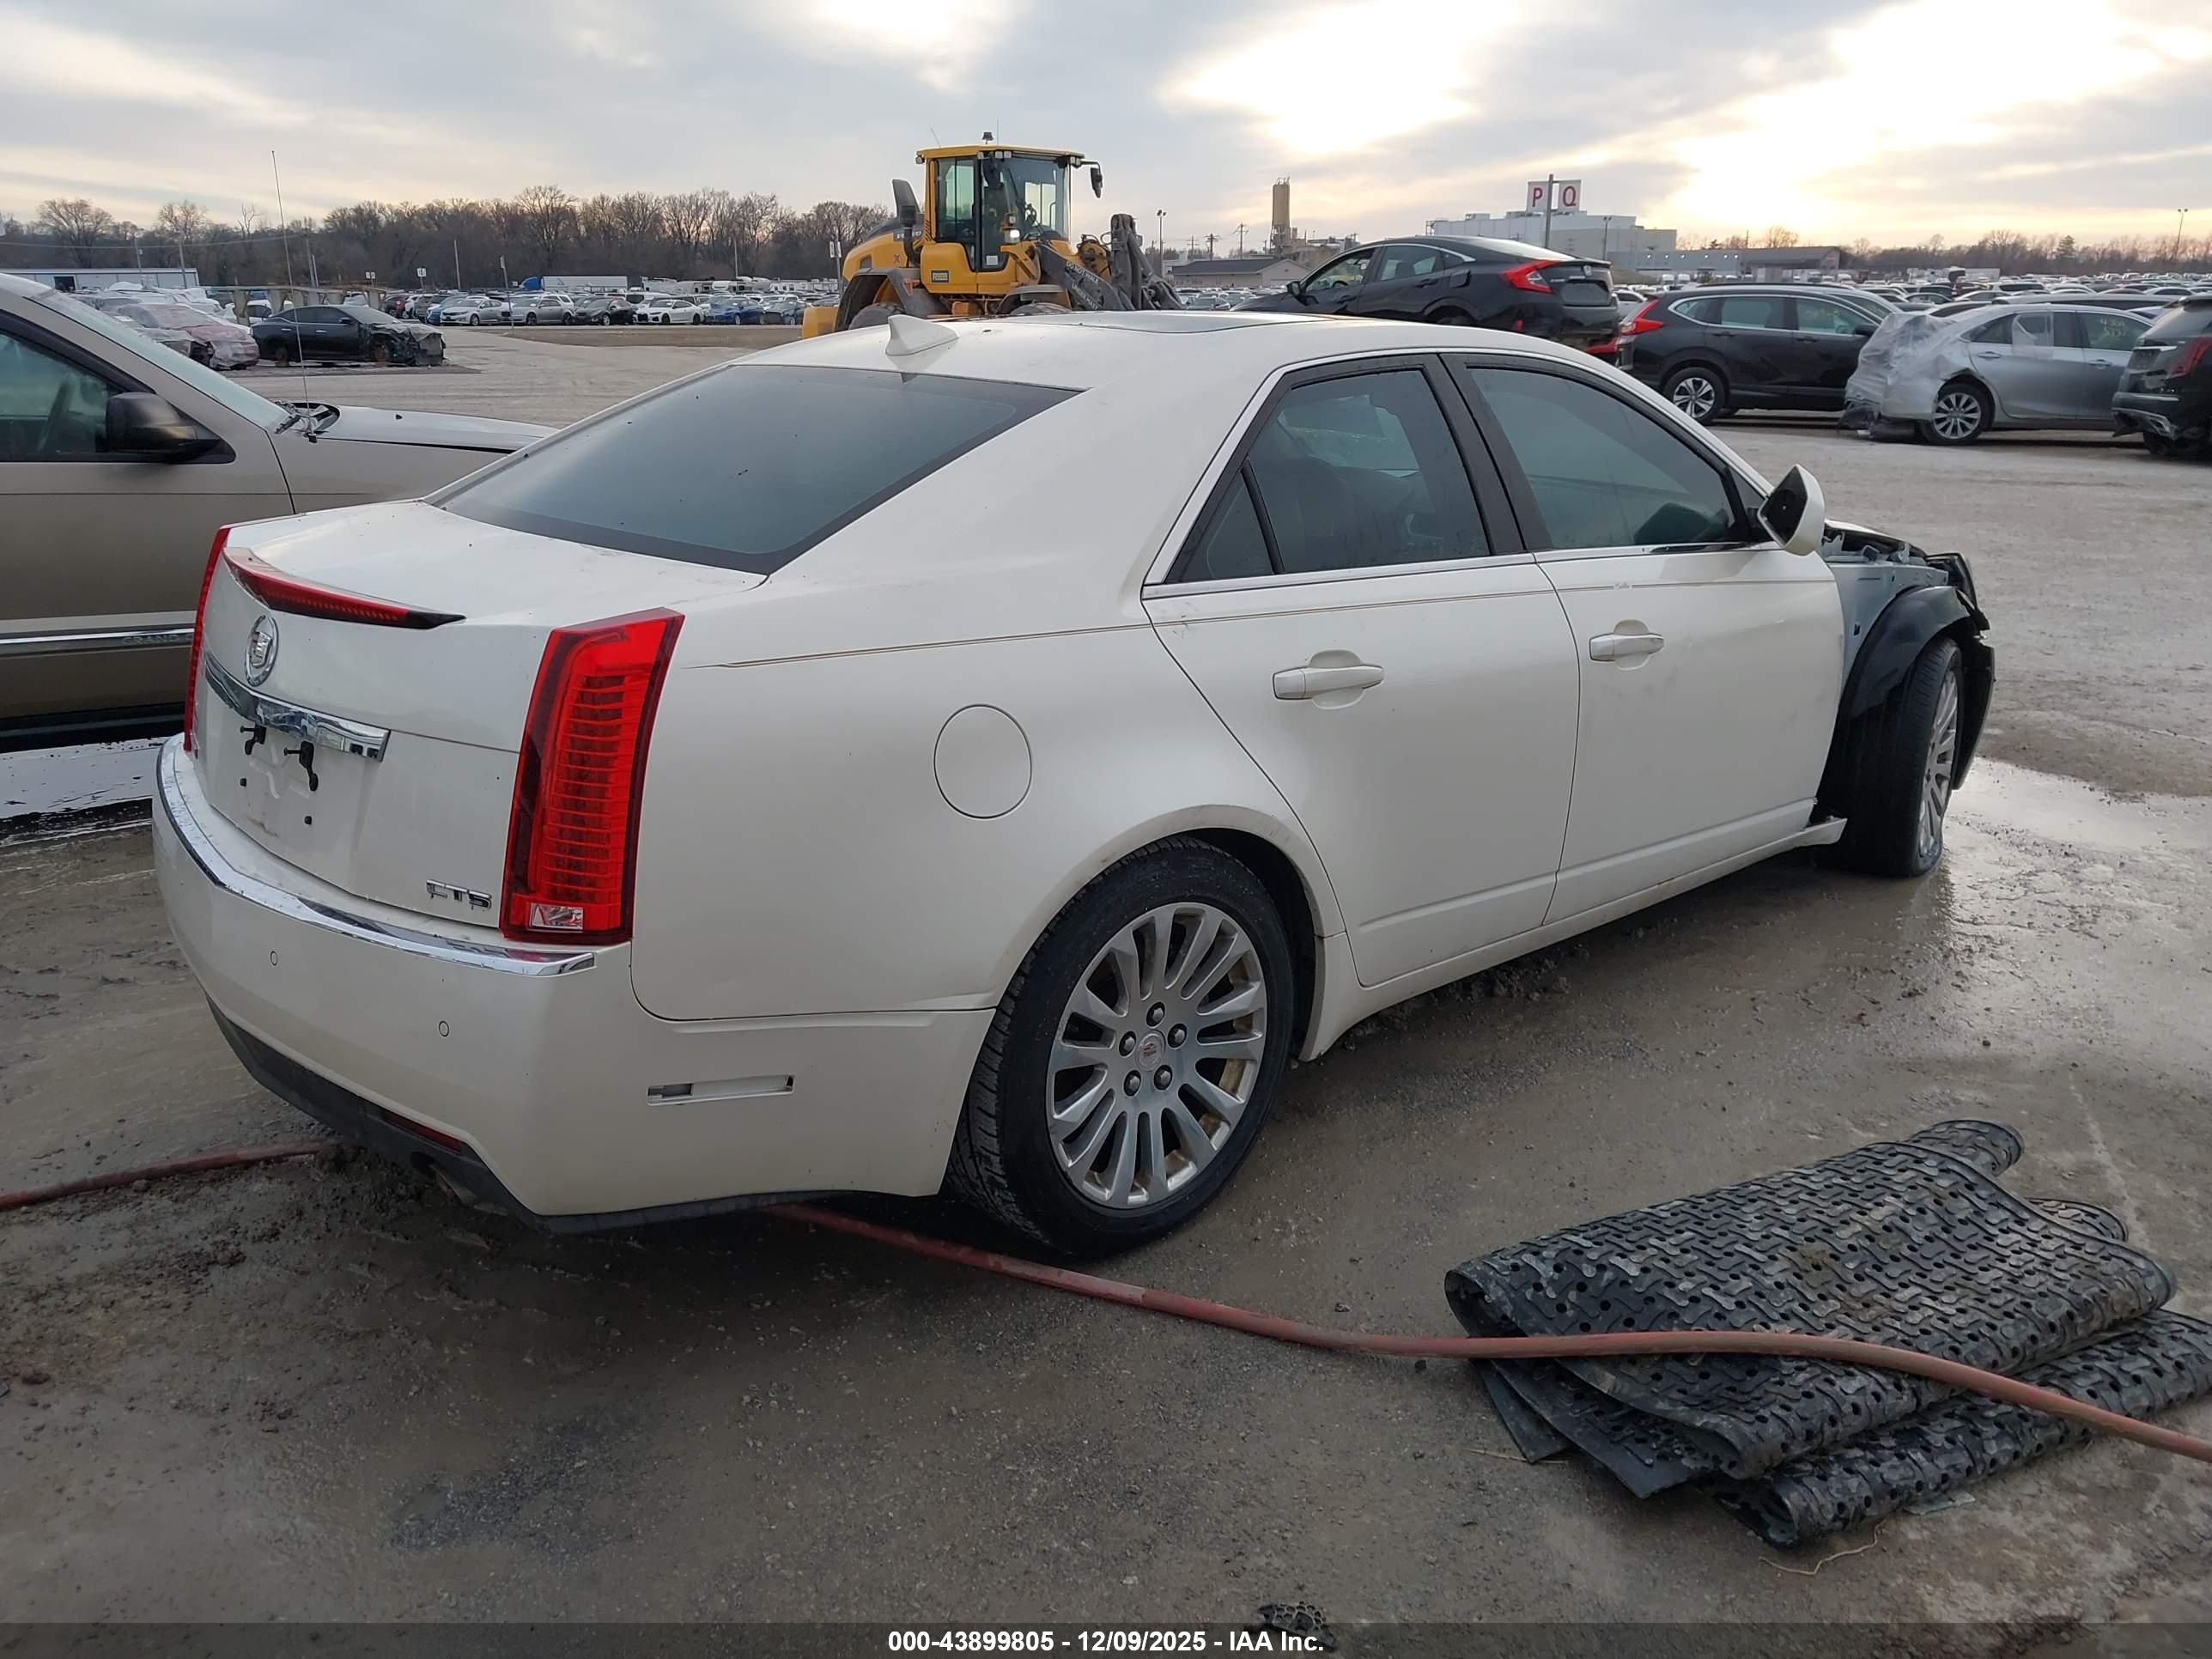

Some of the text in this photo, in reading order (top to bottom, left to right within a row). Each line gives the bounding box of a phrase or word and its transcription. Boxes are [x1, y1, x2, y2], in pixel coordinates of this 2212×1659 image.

[1532, 187, 1543, 208] P
[1563, 185, 1577, 207] Q
[123, 634, 179, 646] GRAND
[426, 879, 492, 909] CTS
